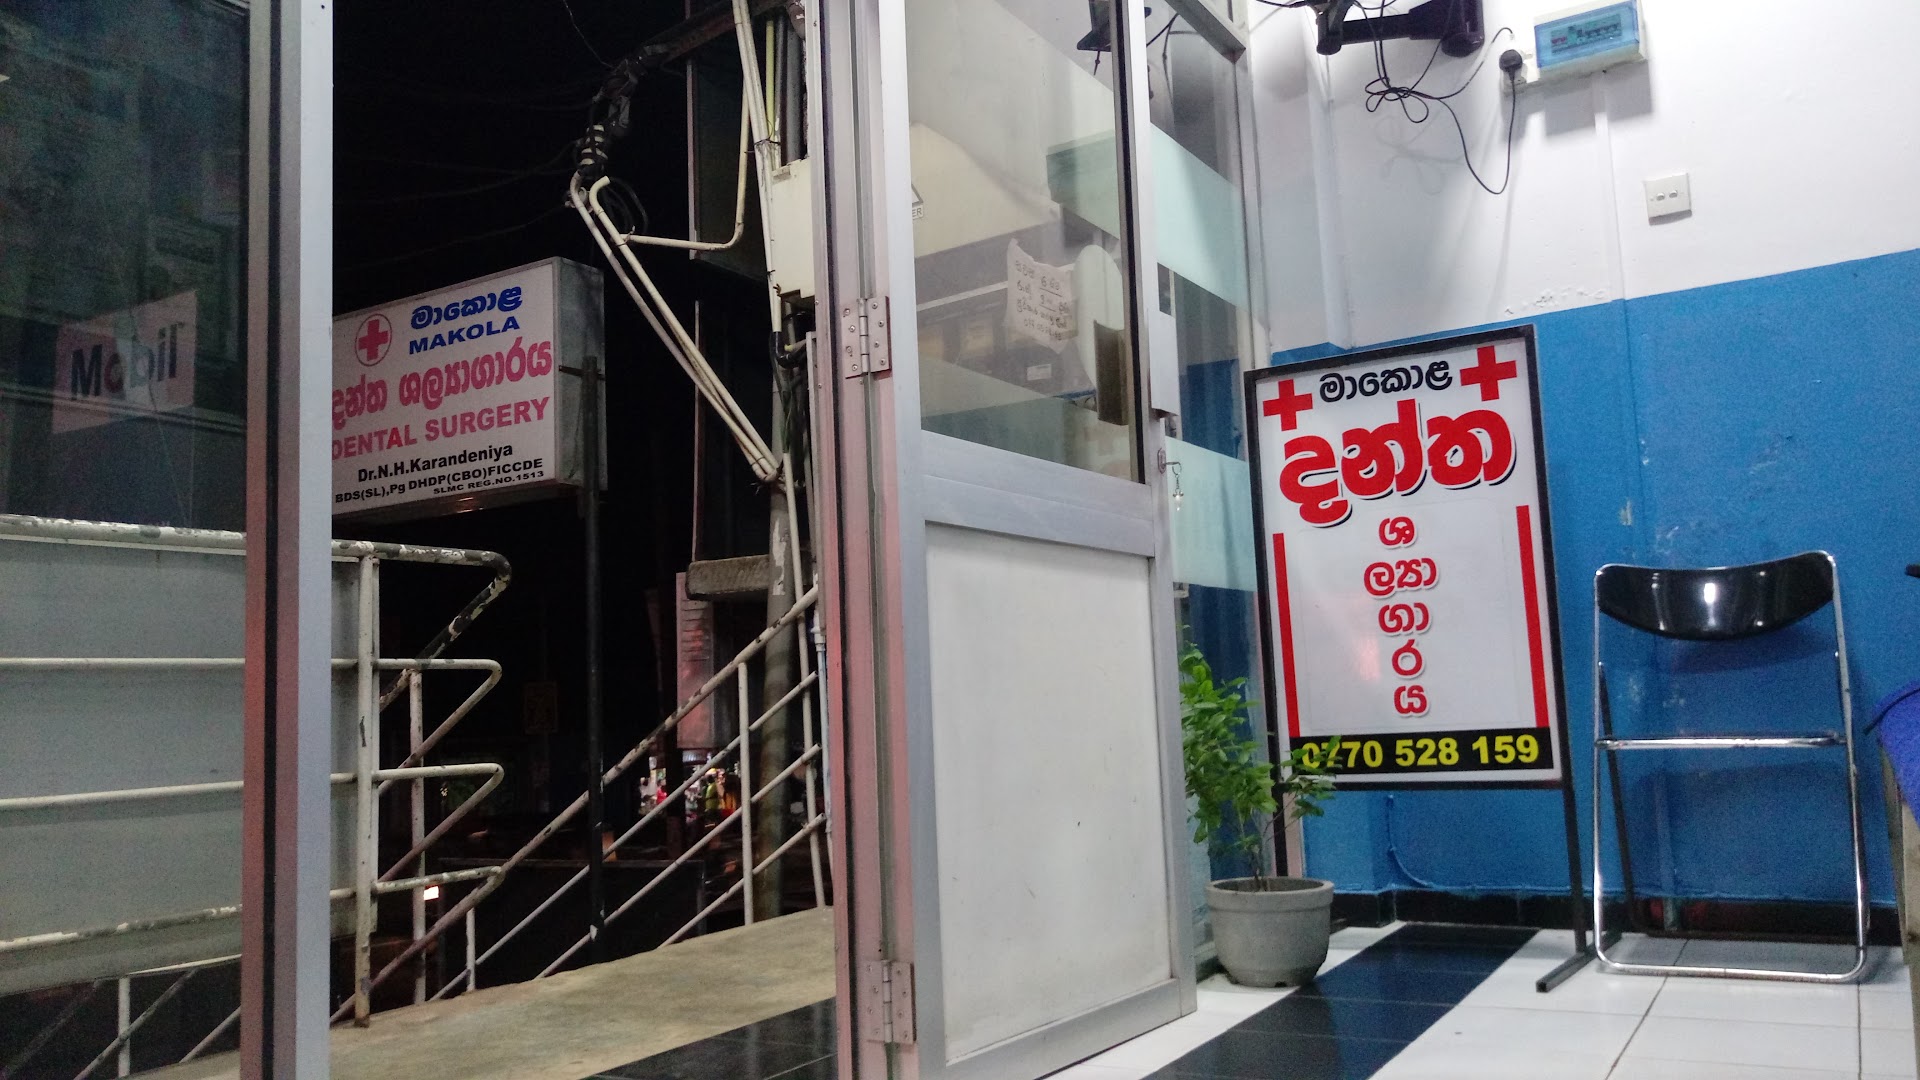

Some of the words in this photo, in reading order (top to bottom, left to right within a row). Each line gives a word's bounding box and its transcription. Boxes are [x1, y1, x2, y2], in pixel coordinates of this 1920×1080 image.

[411, 287, 521, 330] මාකොළ
[409, 316, 520, 354] MAKOLA
[1319, 360, 1453, 402] මාකොළ
[332, 424, 418, 460] DENTAL
[425, 396, 549, 441] SURGERY
[358, 445, 513, 482] Dr.N.H.Karandeniya
[1279, 398, 1516, 528] දන්ත
[433, 483, 464, 495] SLMC
[1302, 740, 1383, 769] 0770
[1395, 738, 1459, 766] 528
[1472, 734, 1539, 764] 159
